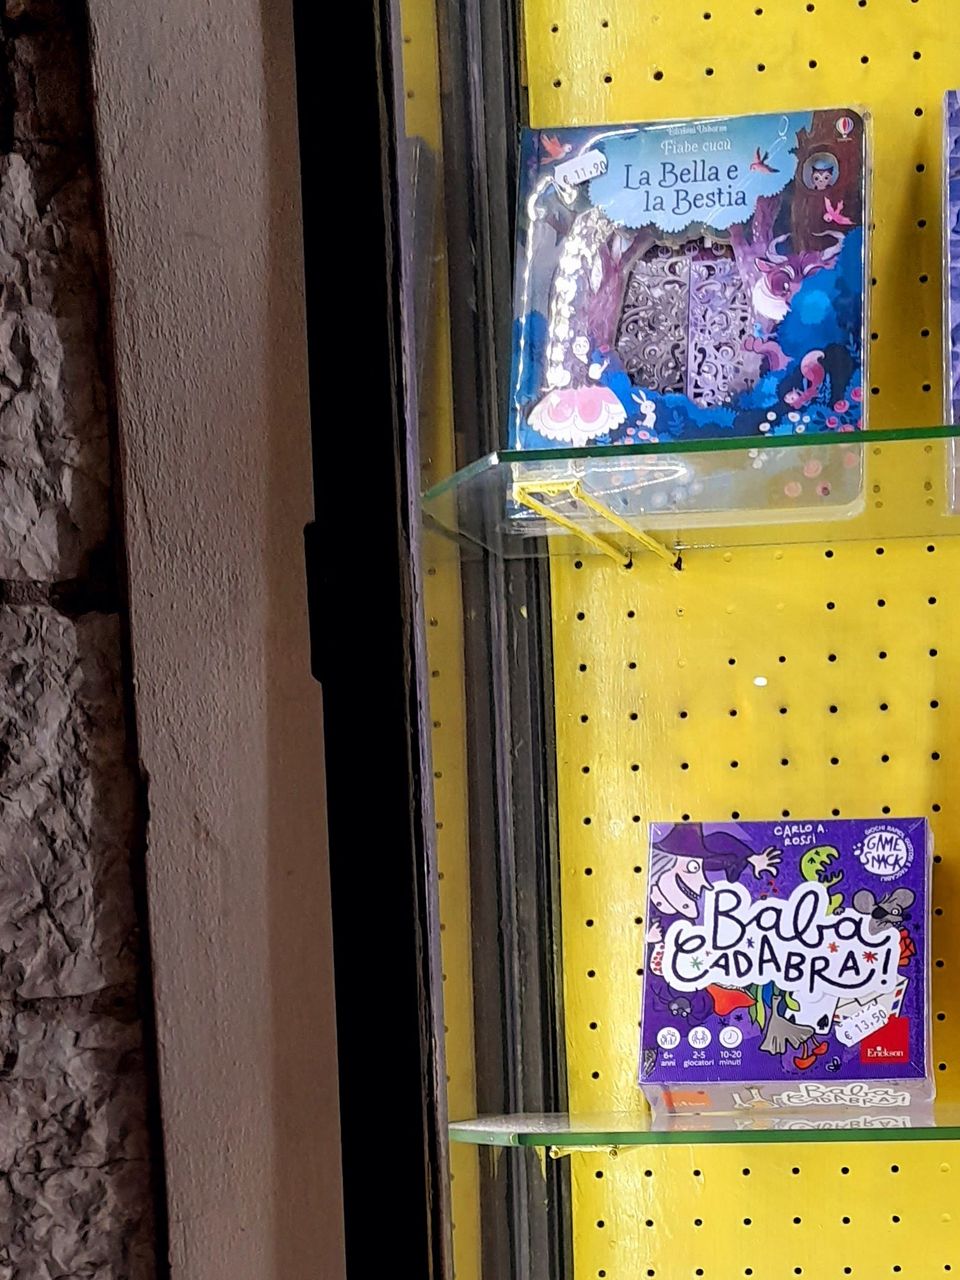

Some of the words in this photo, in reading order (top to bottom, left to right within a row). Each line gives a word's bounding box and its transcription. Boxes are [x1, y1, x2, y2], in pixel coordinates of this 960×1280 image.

[661, 139, 698, 155] Fiabe
[702, 139, 732, 152] cucù
[623, 164, 650, 190] La
[658, 160, 720, 188] Bella
[727, 164, 739, 180] e
[643, 190, 665, 212] la
[672, 185, 748, 215] Bestia
[774, 824, 813, 838] CARLO
[817, 824, 829, 834] A.
[784, 833, 816, 846] ROSSI
[867, 834, 902, 852] GAME
[864, 851, 904, 872] SNACK
[712, 888, 892, 949] Baba
[663, 1051, 674, 1059] 6+
[692, 1051, 706, 1059] 2-5
[719, 1051, 742, 1059] 10-20
[866, 1045, 904, 1058] Erickson
[660, 1059, 676, 1067] anni
[683, 1059, 715, 1069] giocatori
[719, 1059, 742, 1067] minuti
